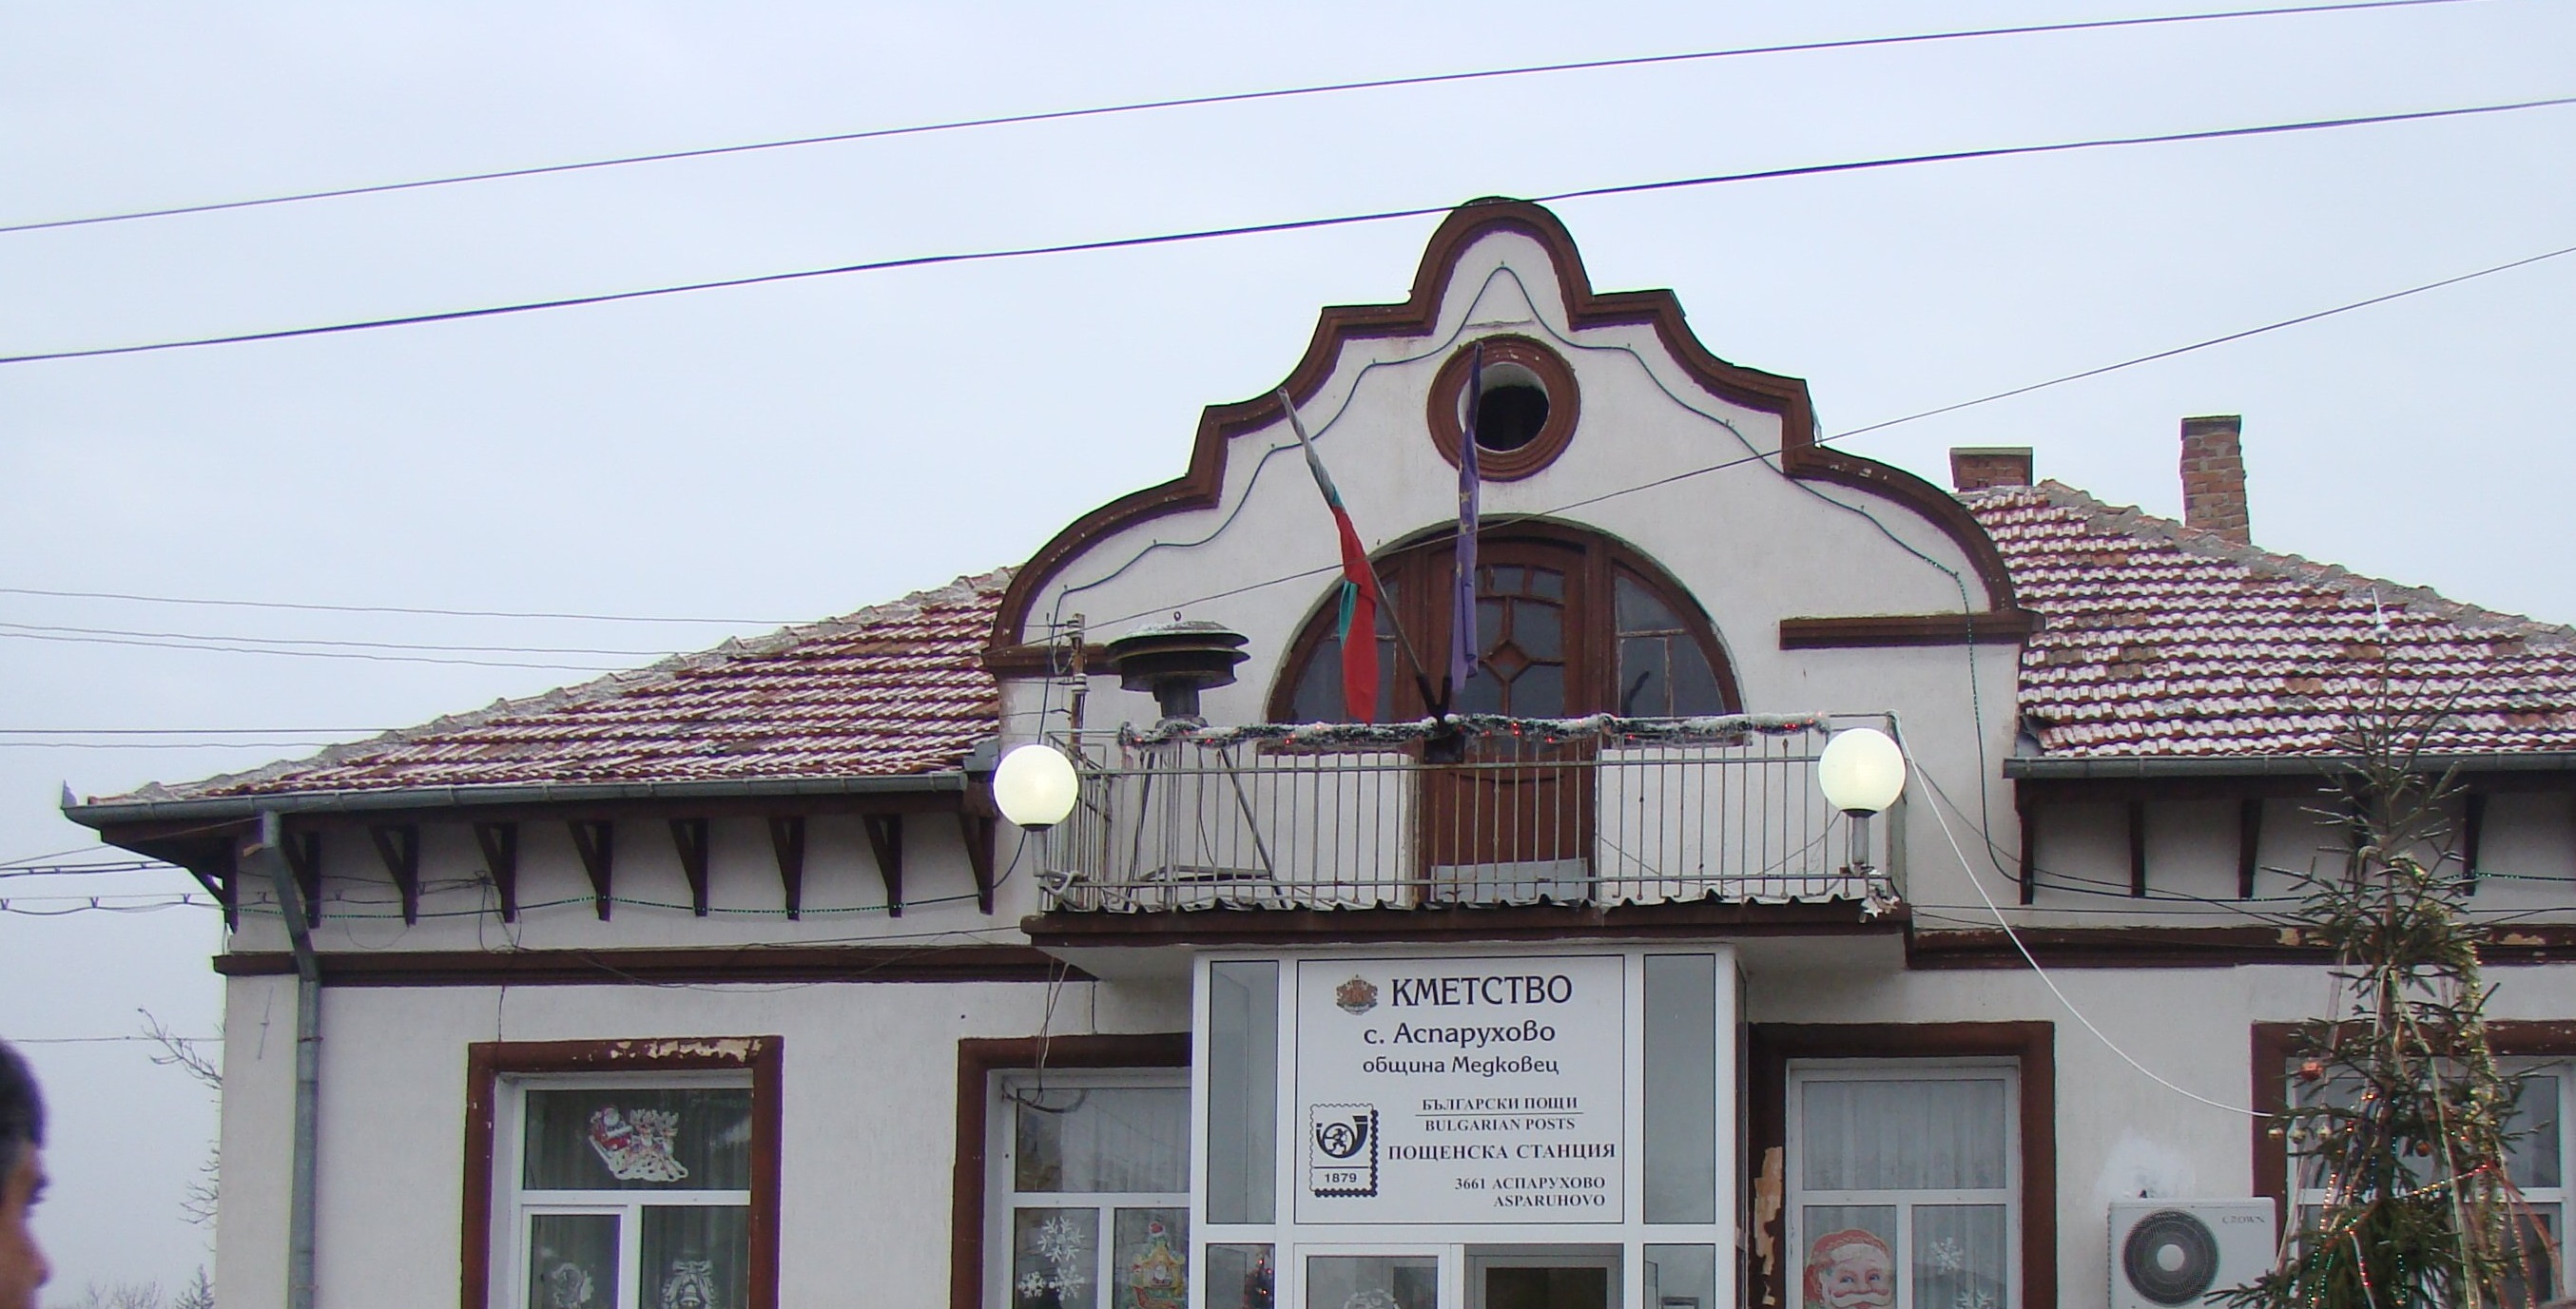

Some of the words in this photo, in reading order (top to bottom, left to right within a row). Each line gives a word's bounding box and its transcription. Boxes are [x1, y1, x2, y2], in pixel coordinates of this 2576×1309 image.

[1391, 974, 1573, 1007] КМЕТСТВО
[1364, 1029, 1385, 1045] с.
[1392, 1019, 1556, 1049] Аспарухово
[1363, 1055, 1445, 1076] община
[1451, 1055, 1559, 1078] Медковец
[1423, 1097, 1519, 1111] БЪЛГАРСКИ
[1524, 1097, 1578, 1109] ПОЩИ
[1425, 1119, 1520, 1132] BULGARIAN
[1525, 1118, 1576, 1130] POSTS
[1388, 1145, 1508, 1162] ПОЩЕНСКА
[1516, 1144, 1615, 1160] СТАНЦИЯ
[1325, 1172, 1357, 1184] 1879
[1455, 1178, 1485, 1190] 3661
[1492, 1177, 1605, 1189] АСПАРУХОВО
[1493, 1194, 1605, 1207] ASPARUHOVO
